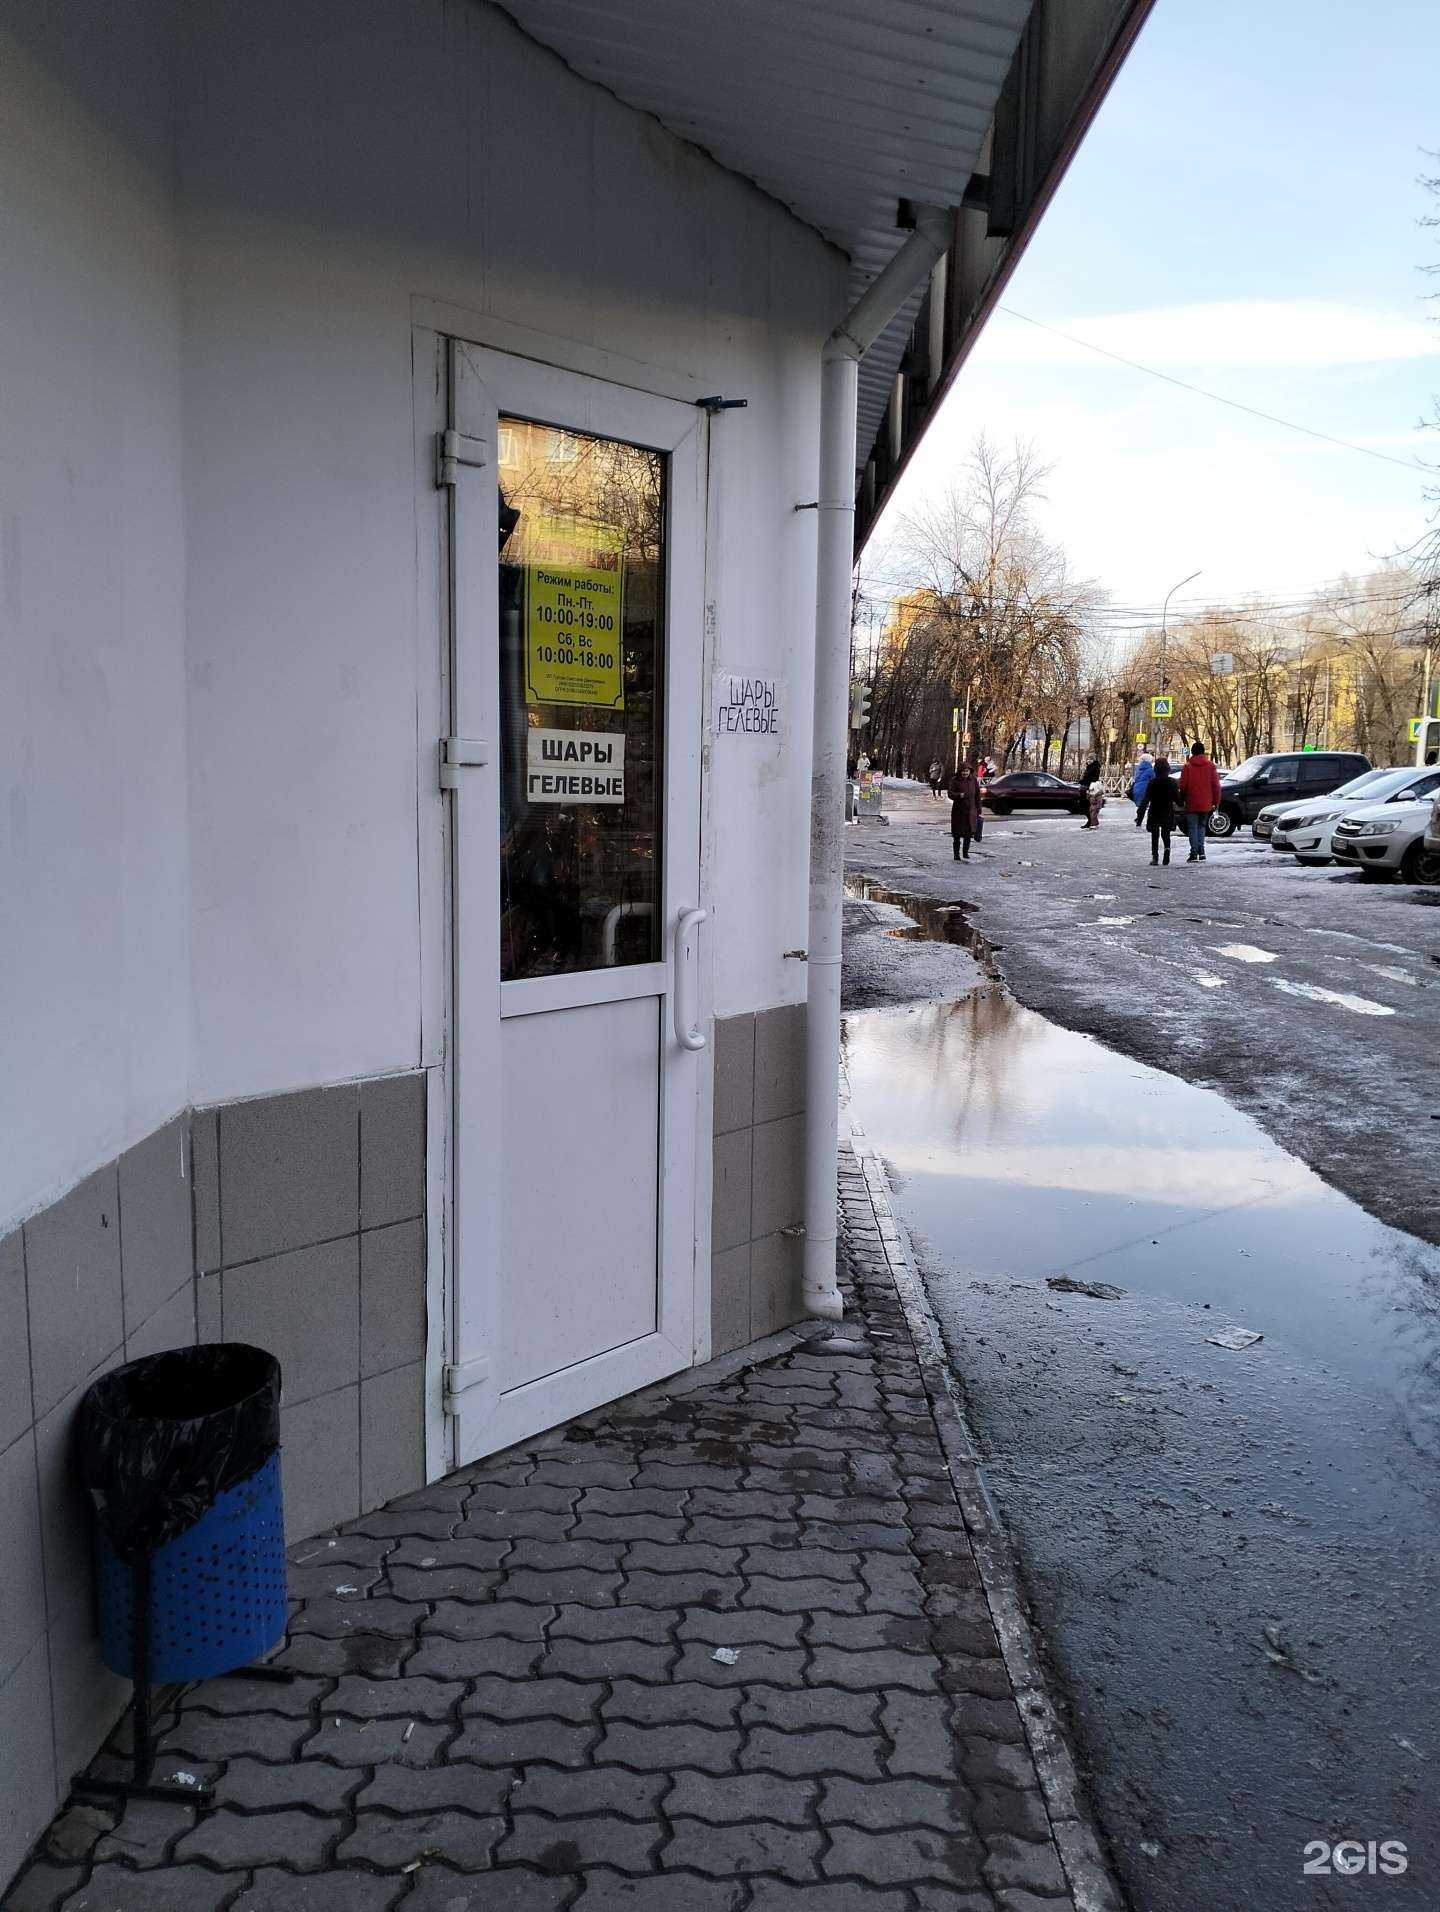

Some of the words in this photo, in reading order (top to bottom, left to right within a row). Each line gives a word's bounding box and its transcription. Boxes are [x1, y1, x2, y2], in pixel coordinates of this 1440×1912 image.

[537, 571, 572, 587] Режим
[574, 579, 615, 594] работы:
[537, 605, 613, 631] 10:00-19:00
[557, 632, 575, 648] Сб,
[578, 634, 593, 648] Вс
[537, 645, 613, 669] 10:00-18:00
[730, 677, 775, 708] ШАРЫ
[718, 706, 779, 734] ГЕЛЕВЫЕ
[542, 739, 613, 764] ШАРЫ
[529, 774, 623, 796] ГЕЛЕВЫЕ
